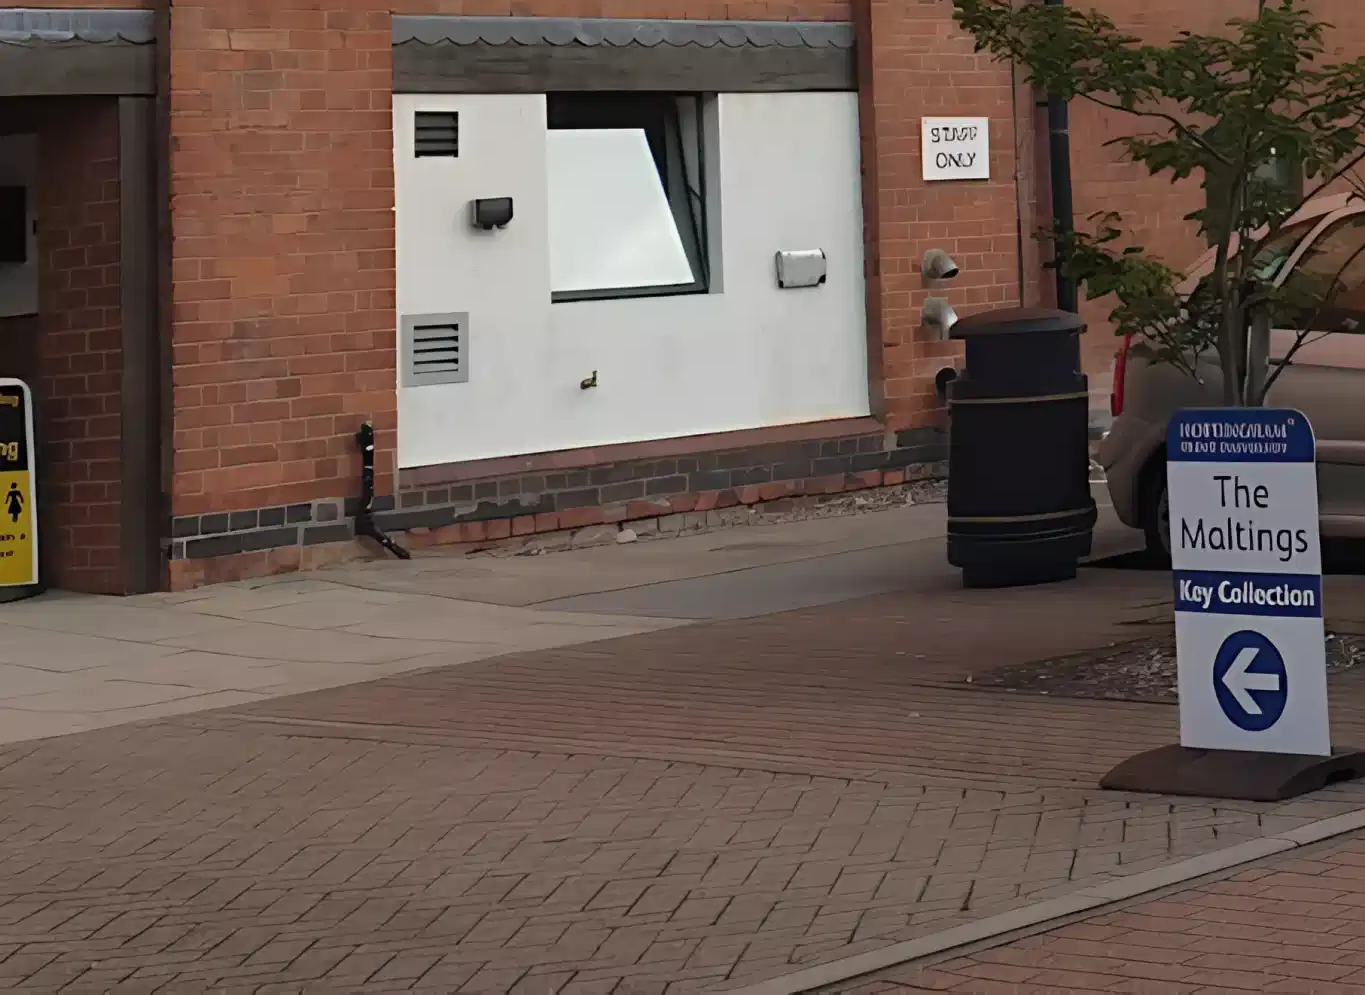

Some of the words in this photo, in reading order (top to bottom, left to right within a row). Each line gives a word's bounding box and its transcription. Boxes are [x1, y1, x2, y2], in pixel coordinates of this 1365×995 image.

[935, 151, 977, 169] ONLY
[1213, 475, 1269, 509] The
[1181, 517, 1309, 563] Maltings
[1179, 578, 1214, 609] Key
[1217, 580, 1316, 607] Collection
